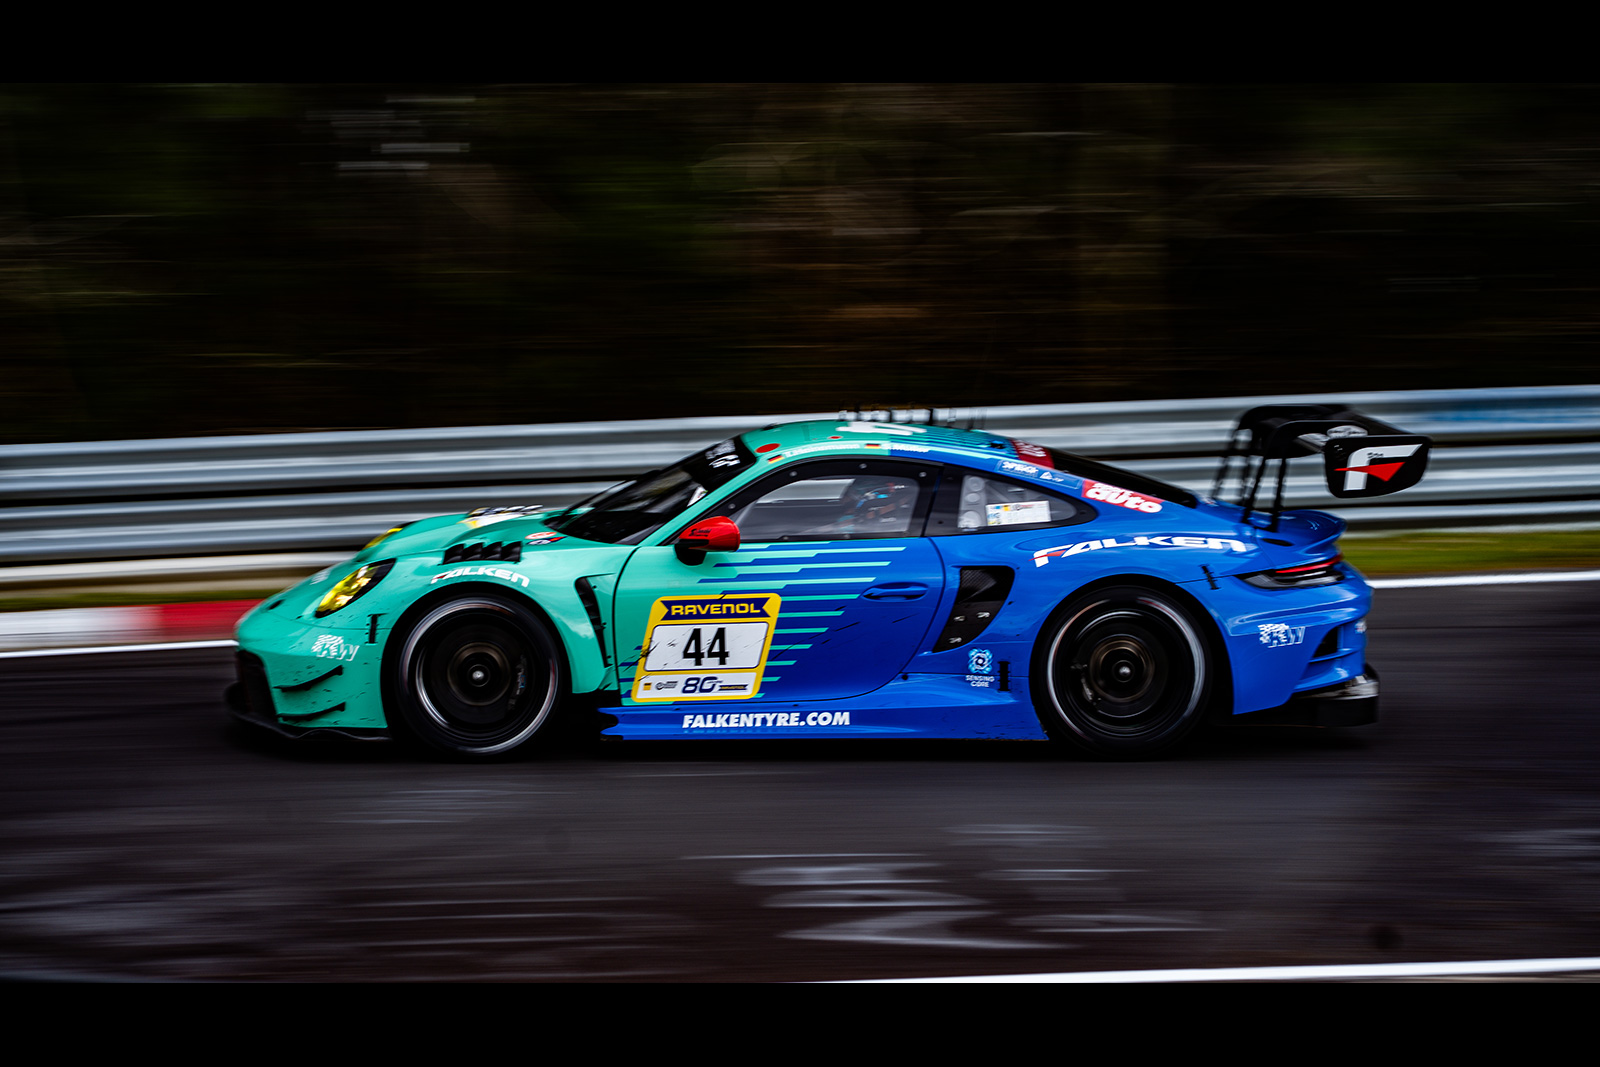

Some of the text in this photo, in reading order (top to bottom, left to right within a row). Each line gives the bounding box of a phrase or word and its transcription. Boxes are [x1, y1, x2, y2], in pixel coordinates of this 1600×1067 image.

[1031, 536, 1248, 568] FALKEN
[430, 567, 530, 588] FALKEN
[670, 603, 761, 616] RAVENOL
[682, 627, 730, 667] 44
[682, 711, 850, 729] FALKENTYRE.COM
